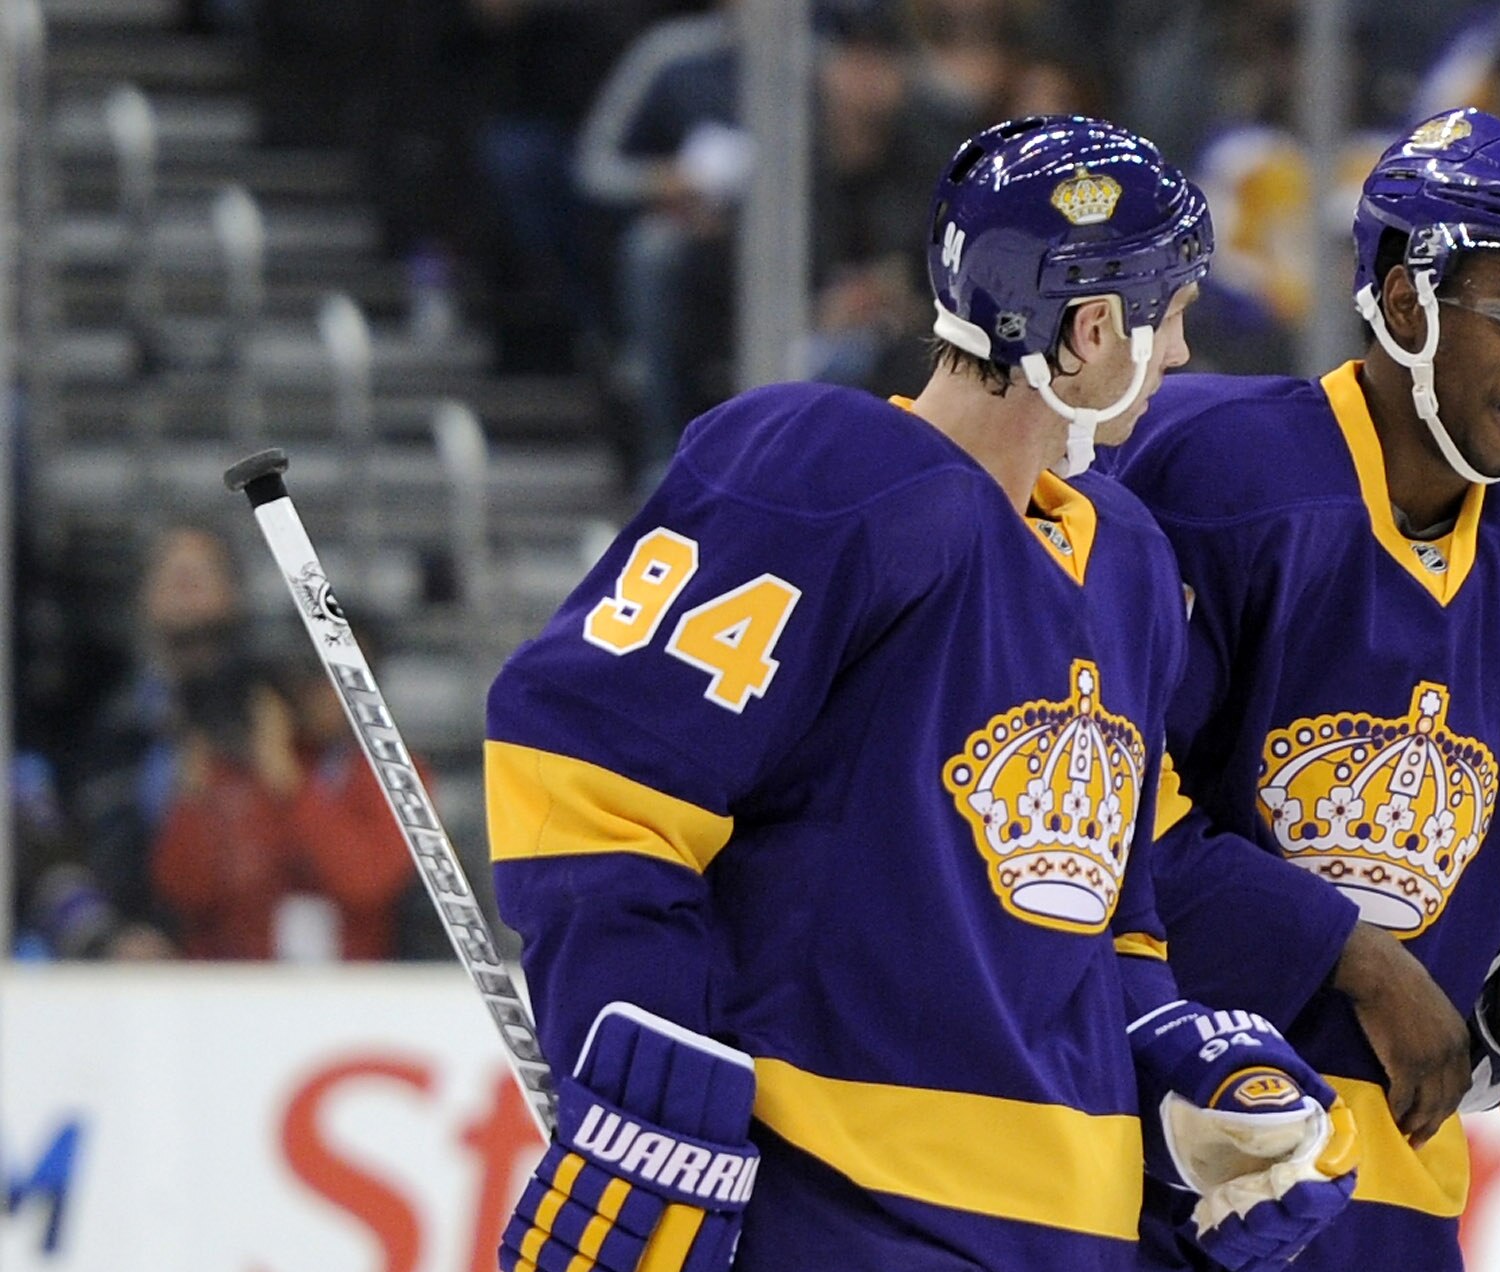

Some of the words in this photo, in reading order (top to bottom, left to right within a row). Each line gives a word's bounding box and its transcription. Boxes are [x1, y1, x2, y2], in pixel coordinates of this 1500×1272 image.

[583, 526, 802, 713] 94
[1199, 1032, 1263, 1062] 94
[573, 1104, 761, 1203] WARRI
